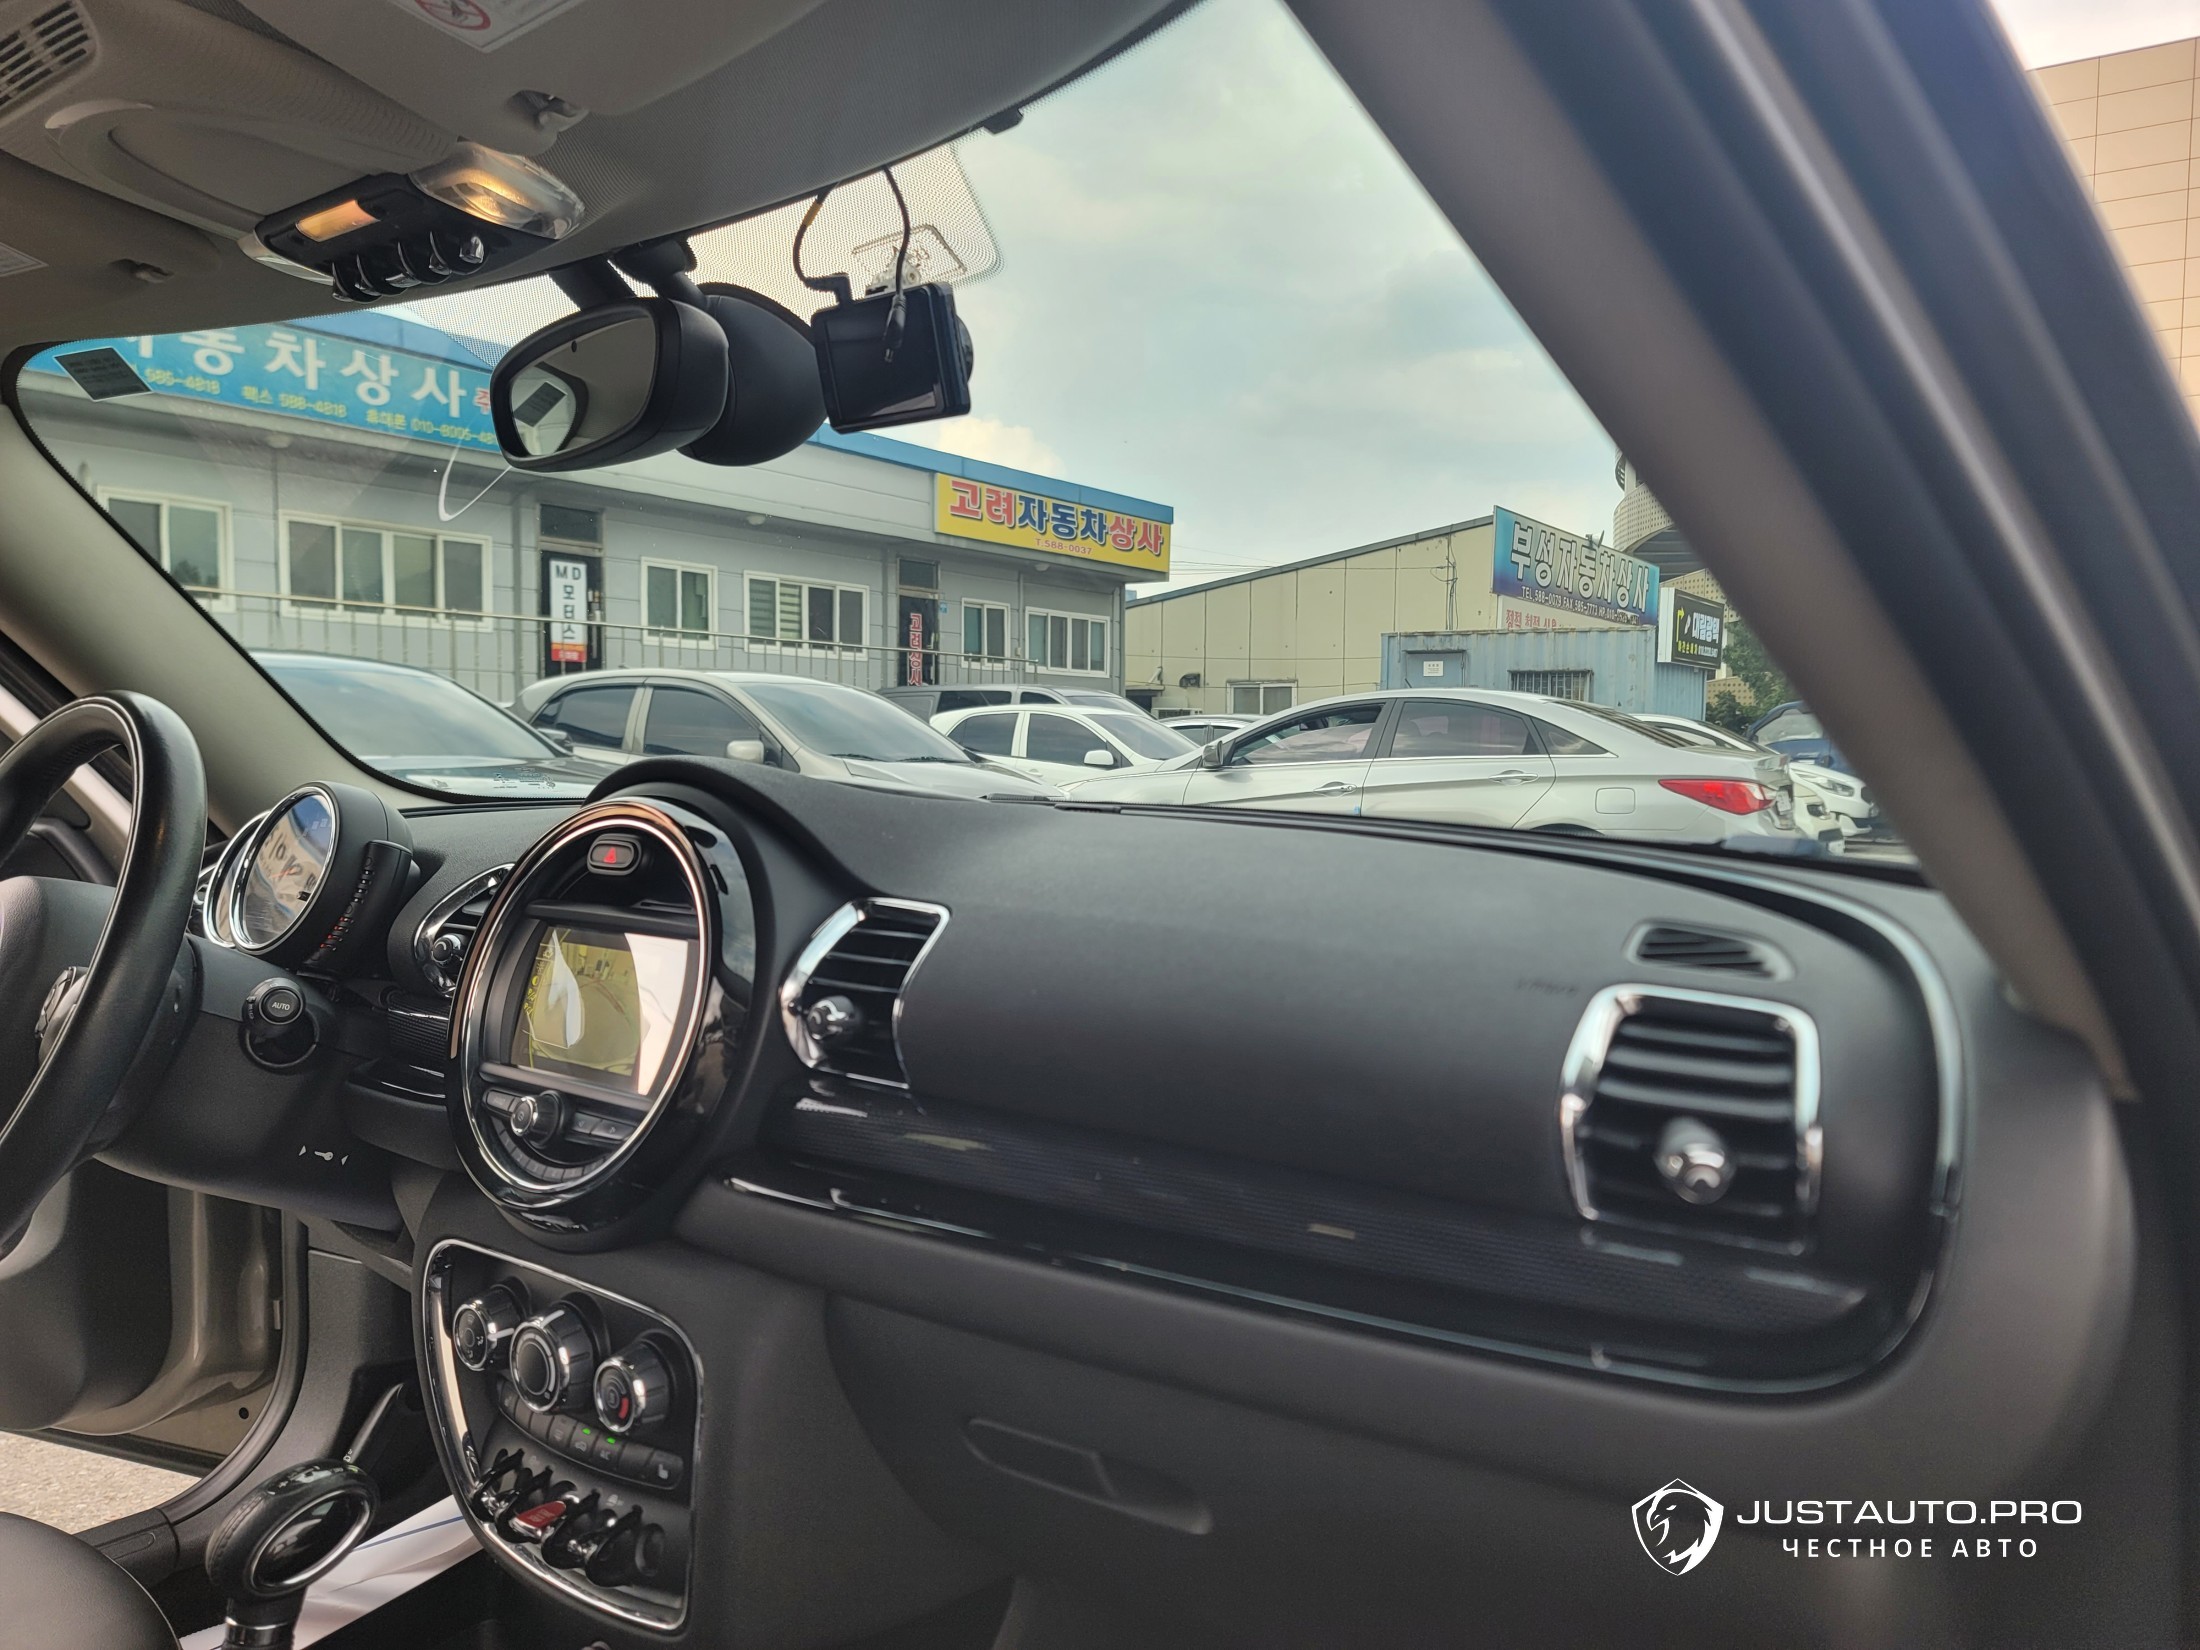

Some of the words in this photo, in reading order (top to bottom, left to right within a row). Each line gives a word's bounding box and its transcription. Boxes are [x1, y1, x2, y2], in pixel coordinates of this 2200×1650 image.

[950, 479, 1164, 556] 고려자동차상사
[1035, 538, 1092, 555] T.588-0037
[1511, 521, 1649, 613] 부성자동차상사
[272, 1001, 291, 1011] AUTO
